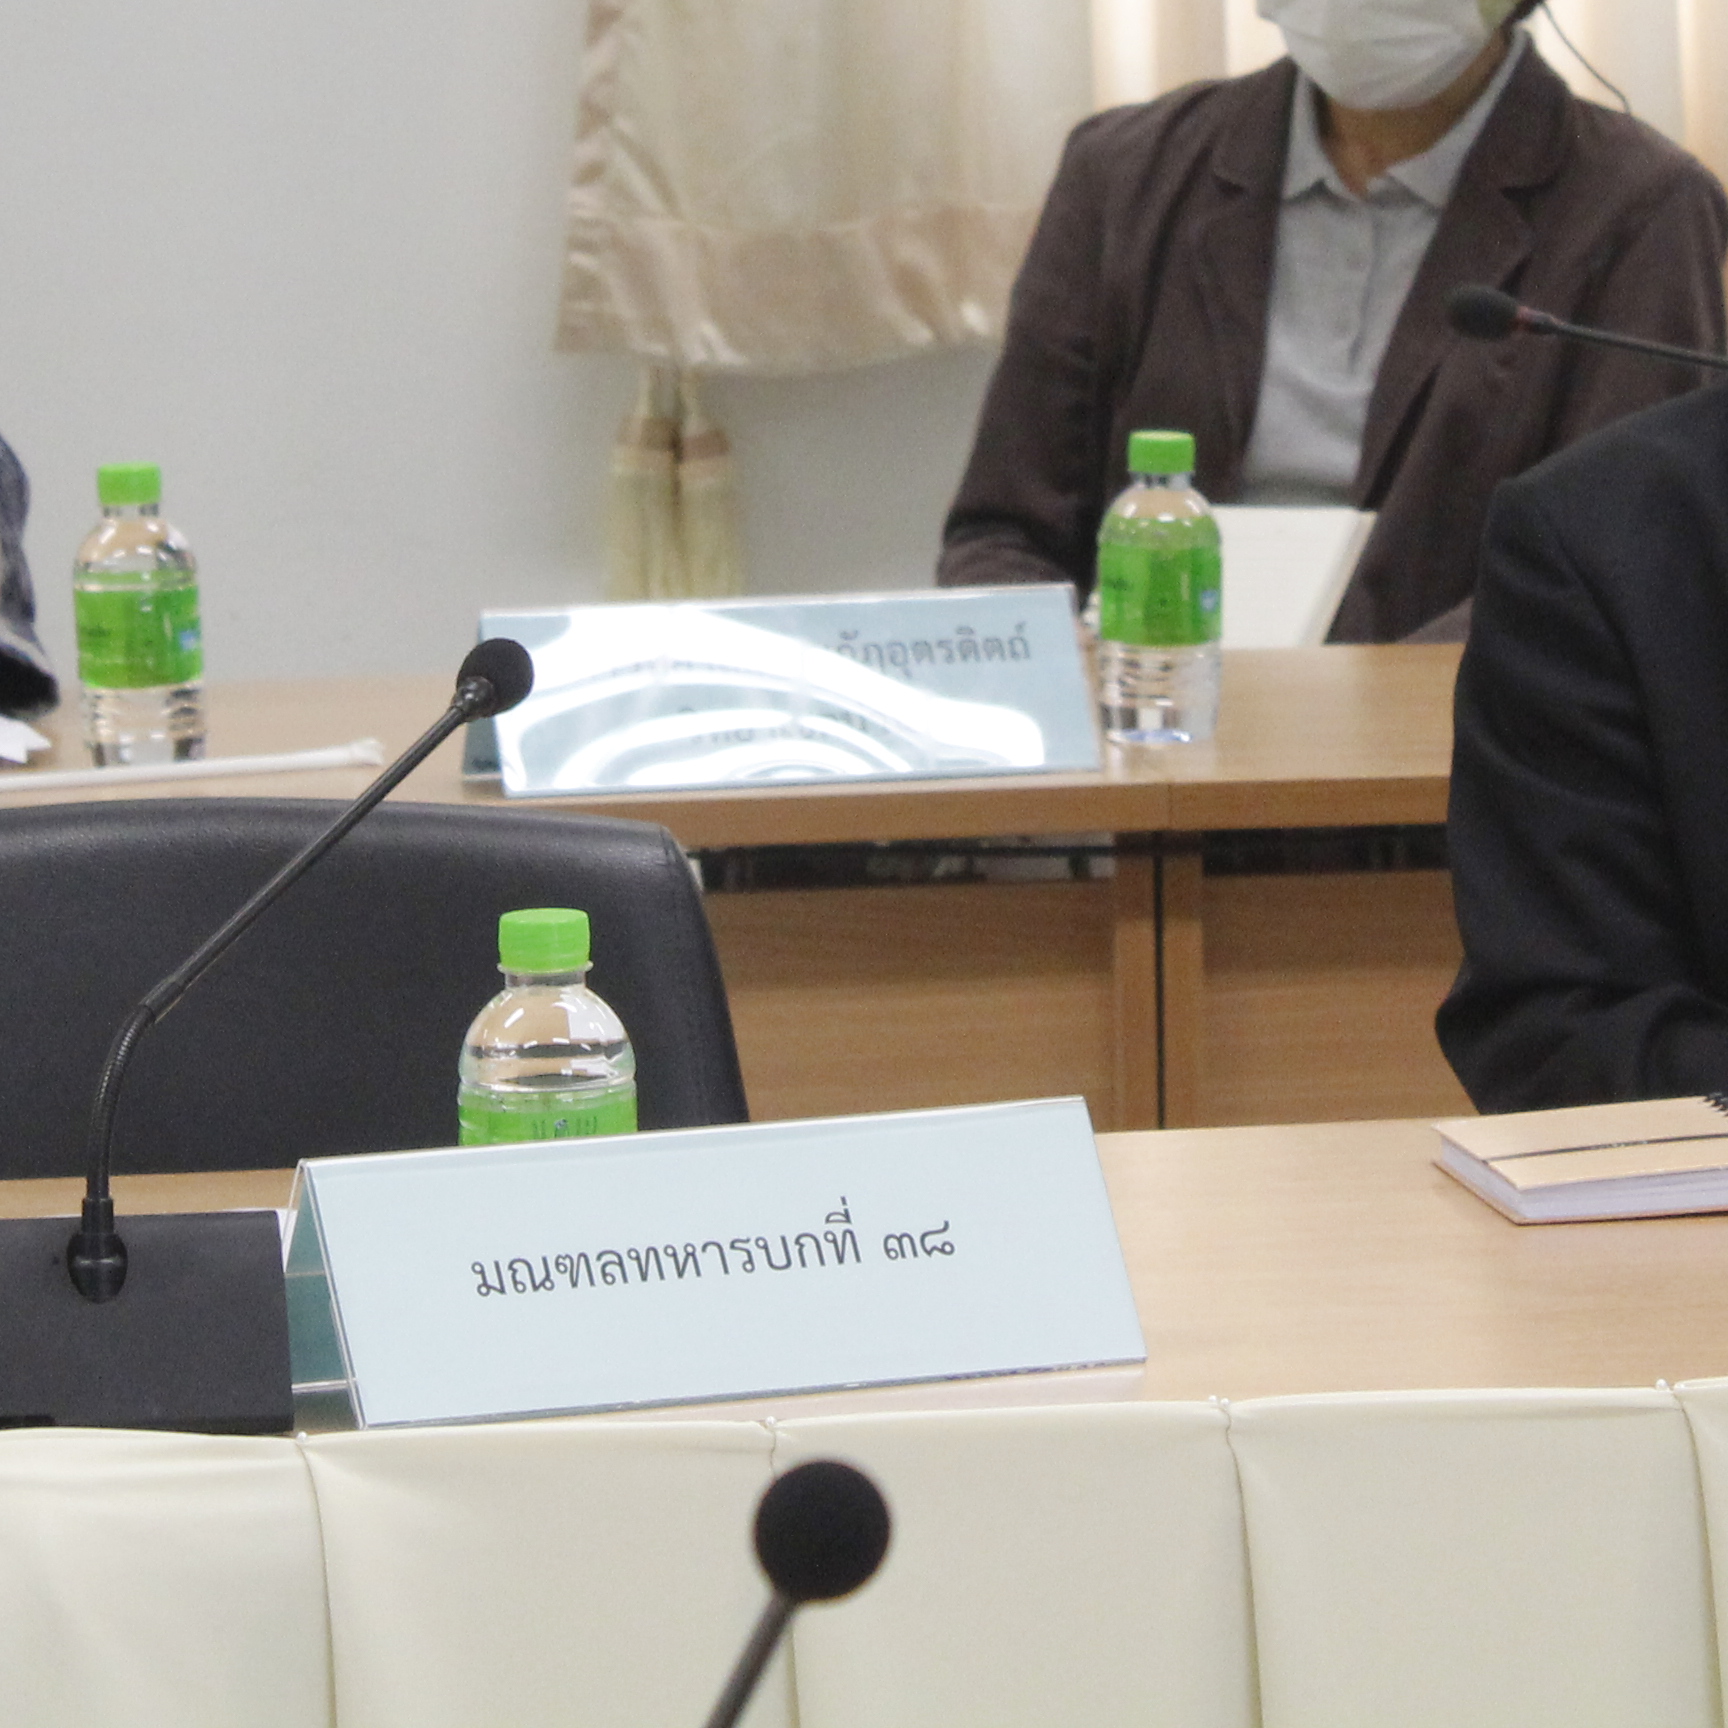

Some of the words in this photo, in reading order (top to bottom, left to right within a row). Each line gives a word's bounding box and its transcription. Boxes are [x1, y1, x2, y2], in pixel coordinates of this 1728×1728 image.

[472, 1196, 861, 1297] มณฑลทหารบกที่
[882, 1219, 957, 1262] ๓๘
